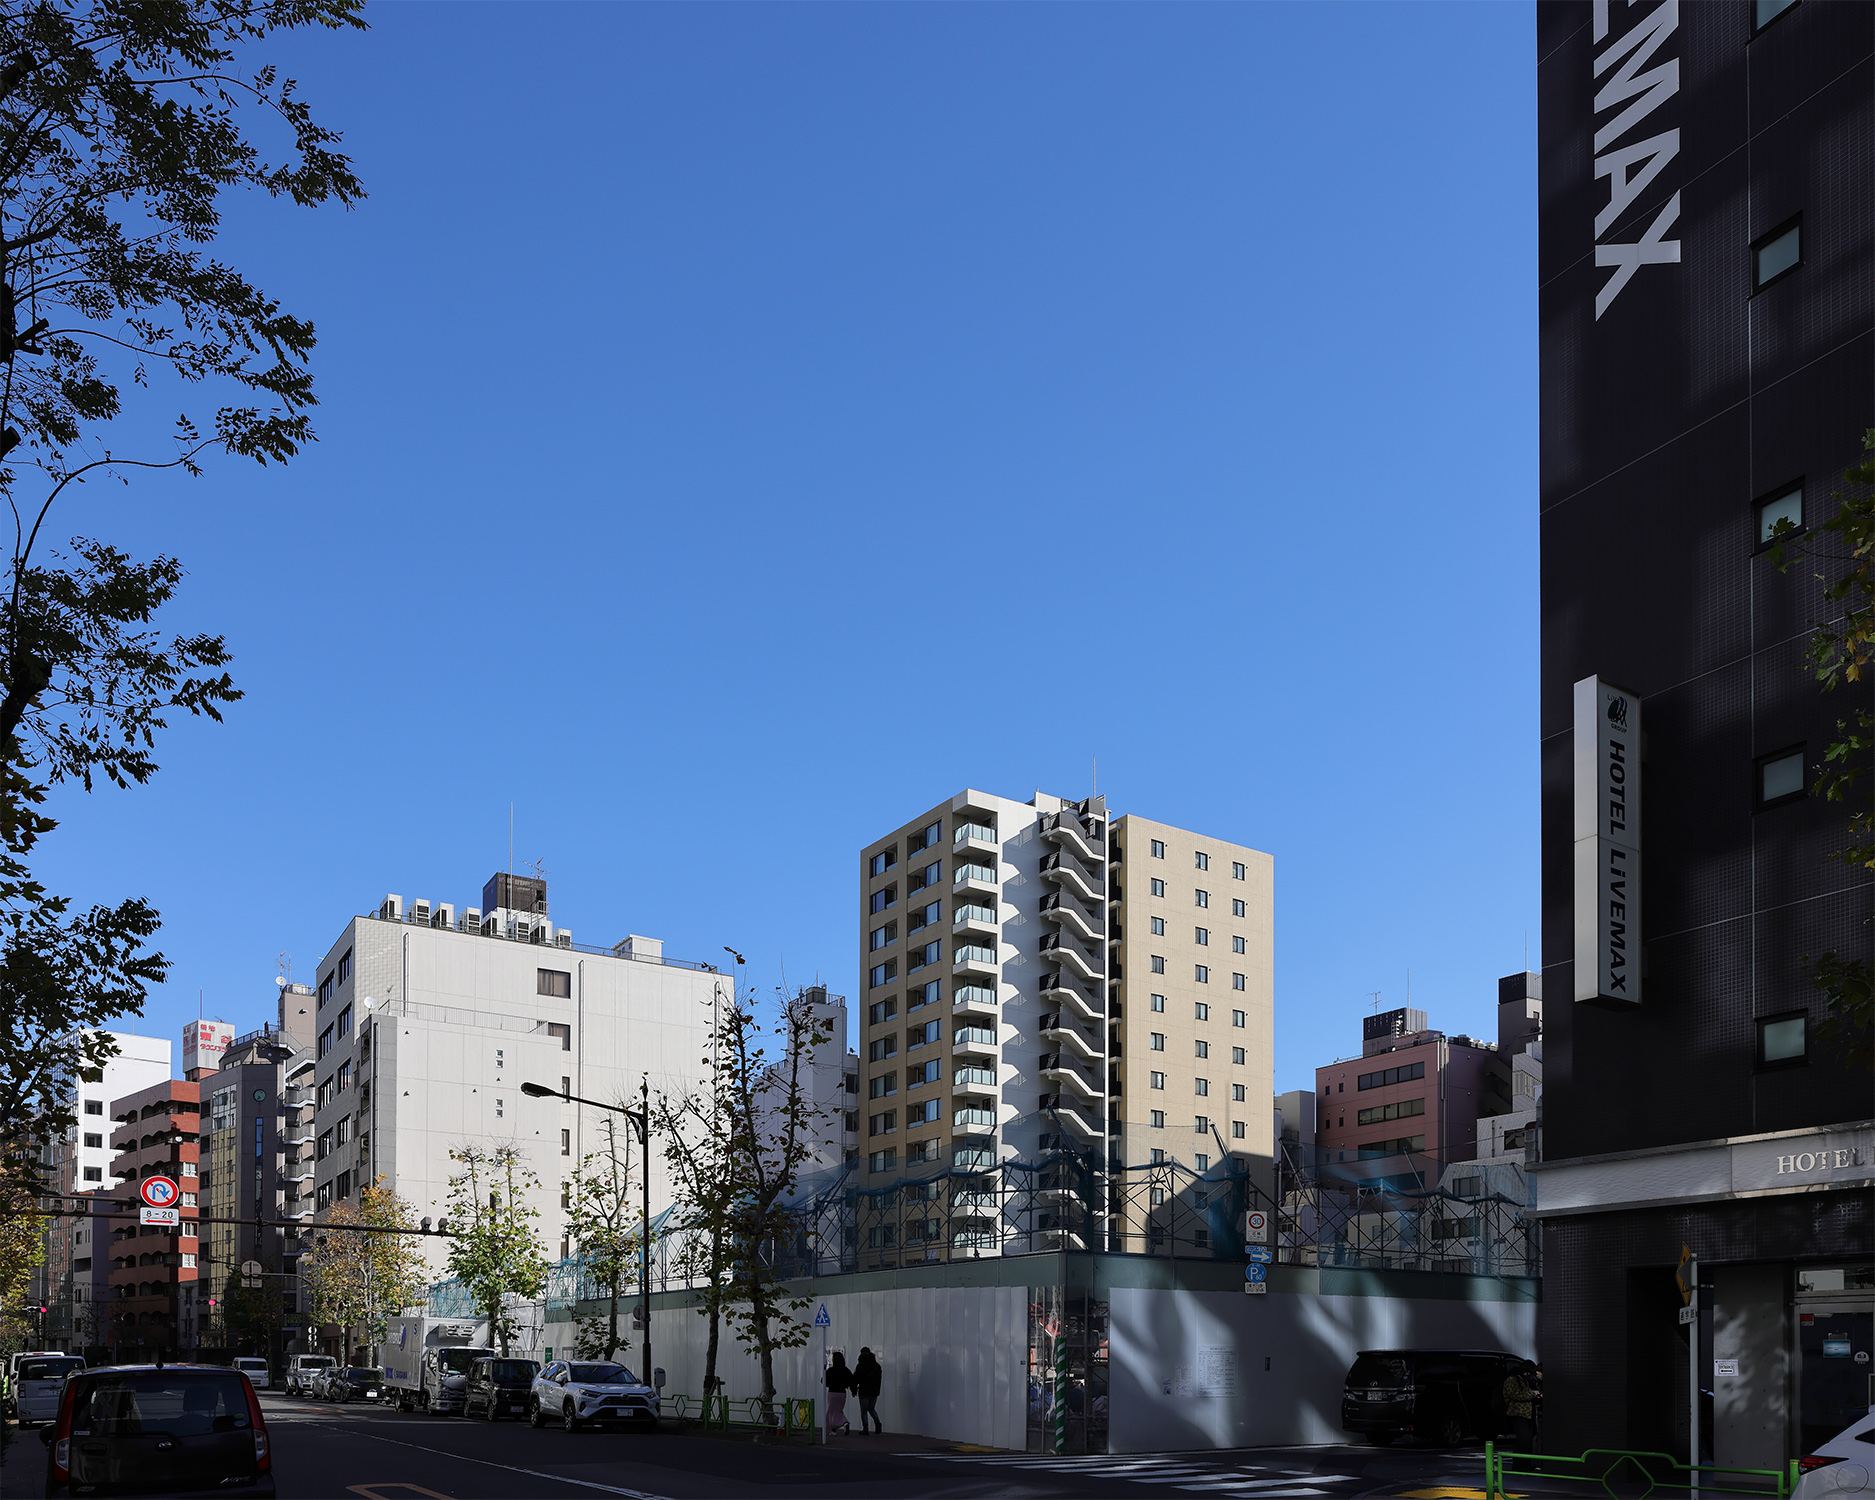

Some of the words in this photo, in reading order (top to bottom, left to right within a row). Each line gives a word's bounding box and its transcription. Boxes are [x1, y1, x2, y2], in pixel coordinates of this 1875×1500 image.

[1609, 738, 1626, 836] HOTEL
[200, 1044, 227, 1052] タウンプラ
[1776, 1147, 1865, 1175] HOTEL
[1252, 1217, 1262, 1225] 30
